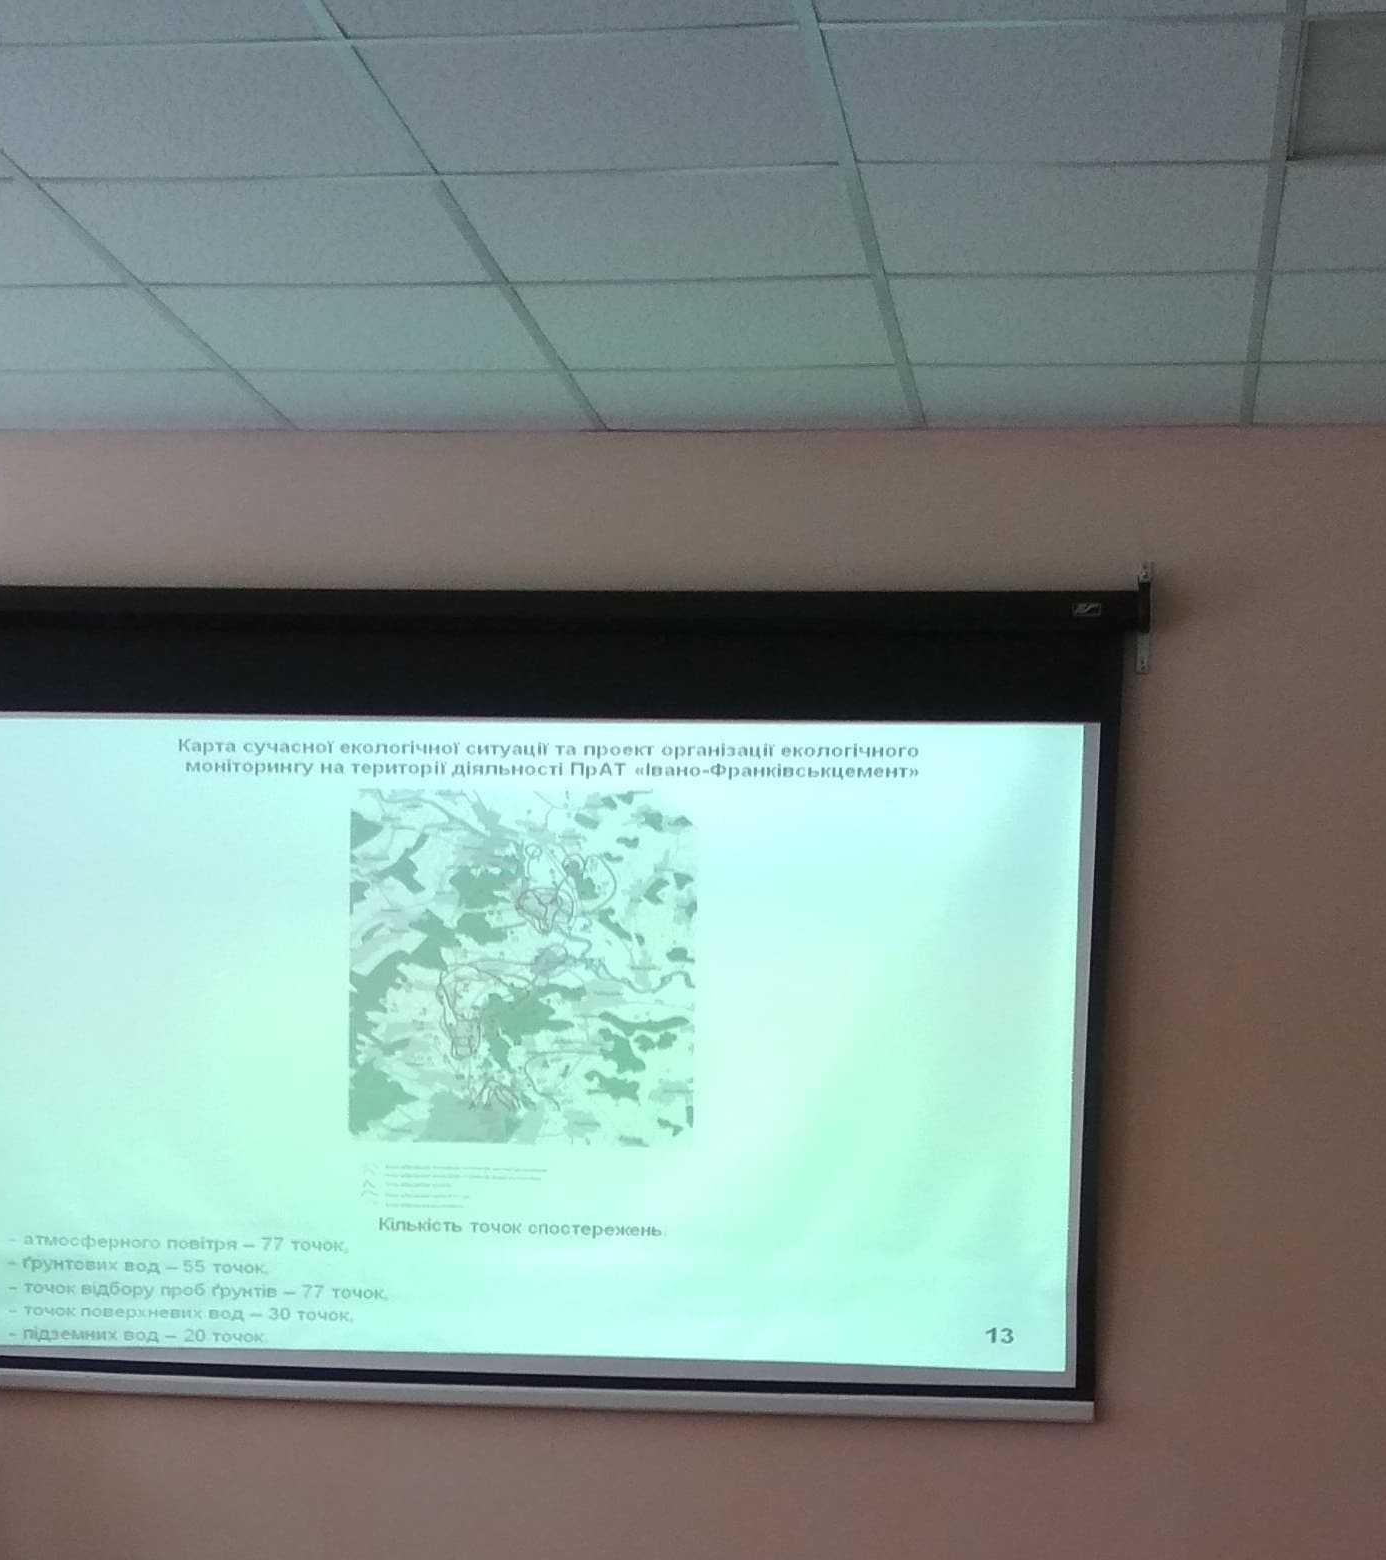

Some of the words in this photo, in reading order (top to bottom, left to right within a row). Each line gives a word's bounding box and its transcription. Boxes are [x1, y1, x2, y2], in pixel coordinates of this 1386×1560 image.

[179, 738, 236, 757] Карта
[243, 740, 334, 757] сучасної
[341, 740, 459, 755] екологічної
[466, 741, 549, 757] ситуації
[556, 745, 575, 756] та
[584, 745, 653, 759] проект
[662, 743, 775, 759] організації
[781, 743, 918, 758] екологічного
[185, 759, 312, 776] моніторингу
[321, 763, 343, 774] на
[351, 761, 445, 778] території
[452, 761, 563, 778] діяльності
[571, 761, 626, 780] ПрАТ
[635, 762, 918, 780] «Івано-Франківськцемент»
[378, 1217, 462, 1233] Кількість
[470, 1221, 521, 1235] точок
[24, 1233, 160, 1252] атмосферного
[167, 1236, 237, 1253] повітря
[261, 1236, 284, 1252] 77
[125, 1261, 160, 1275] вод
[183, 1259, 205, 1273] 55
[24, 1281, 75, 1295] точок
[81, 1280, 154, 1300] відбору
[161, 1283, 205, 1300] проб
[302, 1284, 324, 1299] 77
[24, 1304, 76, 1317] точок
[81, 1305, 202, 1321] поверхневих
[209, 1307, 244, 1322] вод
[269, 1307, 290, 1321] 30
[24, 1327, 116, 1343] підземних
[124, 1329, 159, 1343] вод
[183, 1328, 205, 1343] 20
[985, 1327, 1014, 1344] 13
